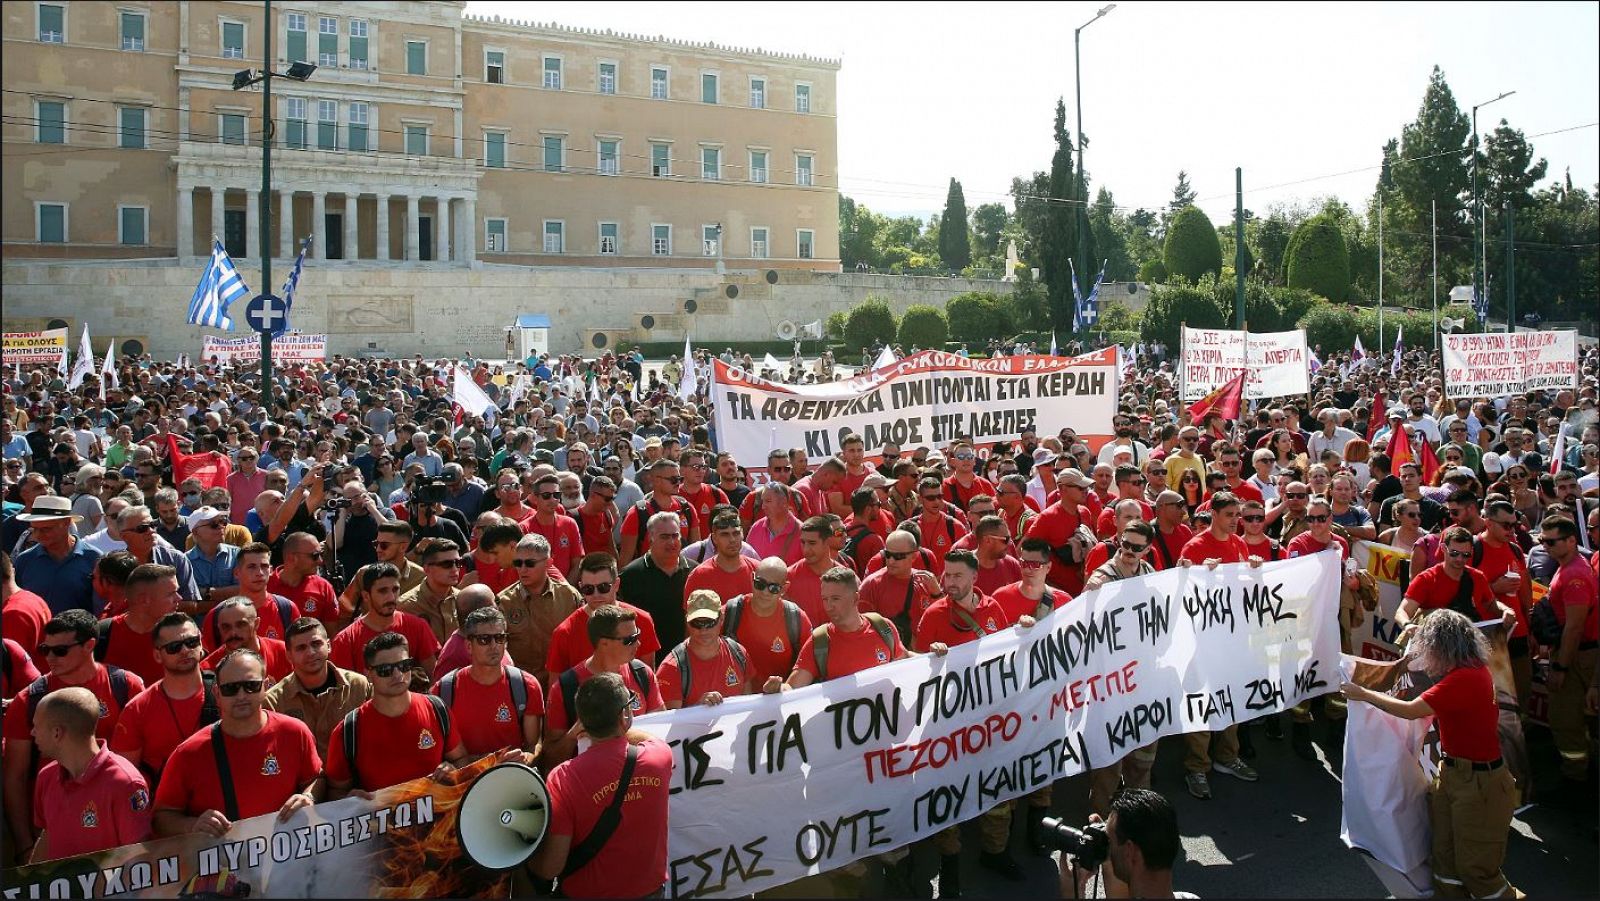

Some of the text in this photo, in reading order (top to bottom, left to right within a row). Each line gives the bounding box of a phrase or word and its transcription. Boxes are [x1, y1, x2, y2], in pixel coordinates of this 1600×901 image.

[27, 338, 58, 346] ΟΛΟΥΣ
[1203, 332, 1219, 345] ΣΣΕ
[1265, 348, 1302, 364] ΑΠΕΡΓΙΑ
[727, 371, 1106, 421] ΤΑ ΑΦΕΝΤΙΚΑ ΠΝΙΓΟΝΤΑΙ ΣΤΑ ΚΕΡΔΗ
[804, 429, 832, 458] ΚΙ
[864, 416, 924, 452] ΛΑΟΣ
[930, 414, 964, 443] ΣΤΙΣ
[968, 408, 1038, 437] ΛΑΣΠΕΣ
[748, 713, 808, 775] ΓΙΑ
[825, 687, 900, 750] ΤΟΝ
[915, 650, 1018, 727] ΠΟΛΙΤΗ
[1028, 607, 1126, 689] ΔΙΝΟΥΜΕ
[1132, 595, 1171, 646] ΤΗΝ
[1183, 584, 1235, 633] ΨΥΧΗ
[1243, 583, 1298, 628] ΜΑΣ
[795, 808, 892, 867] ΟΥΤΕ
[913, 772, 971, 832] ΠΟΥ
[978, 731, 1092, 810] ΚΑΙΓΕΤΑΙ
[1105, 697, 1173, 755] ΚΑΡΦΙ
[1294, 660, 1328, 698] ΜΑΣ
[863, 711, 1022, 784] ΠΕΖΟΠΟΡΟ
[197, 794, 435, 877] ΠΥΡΟΣΒΕΣΤΩΝ
